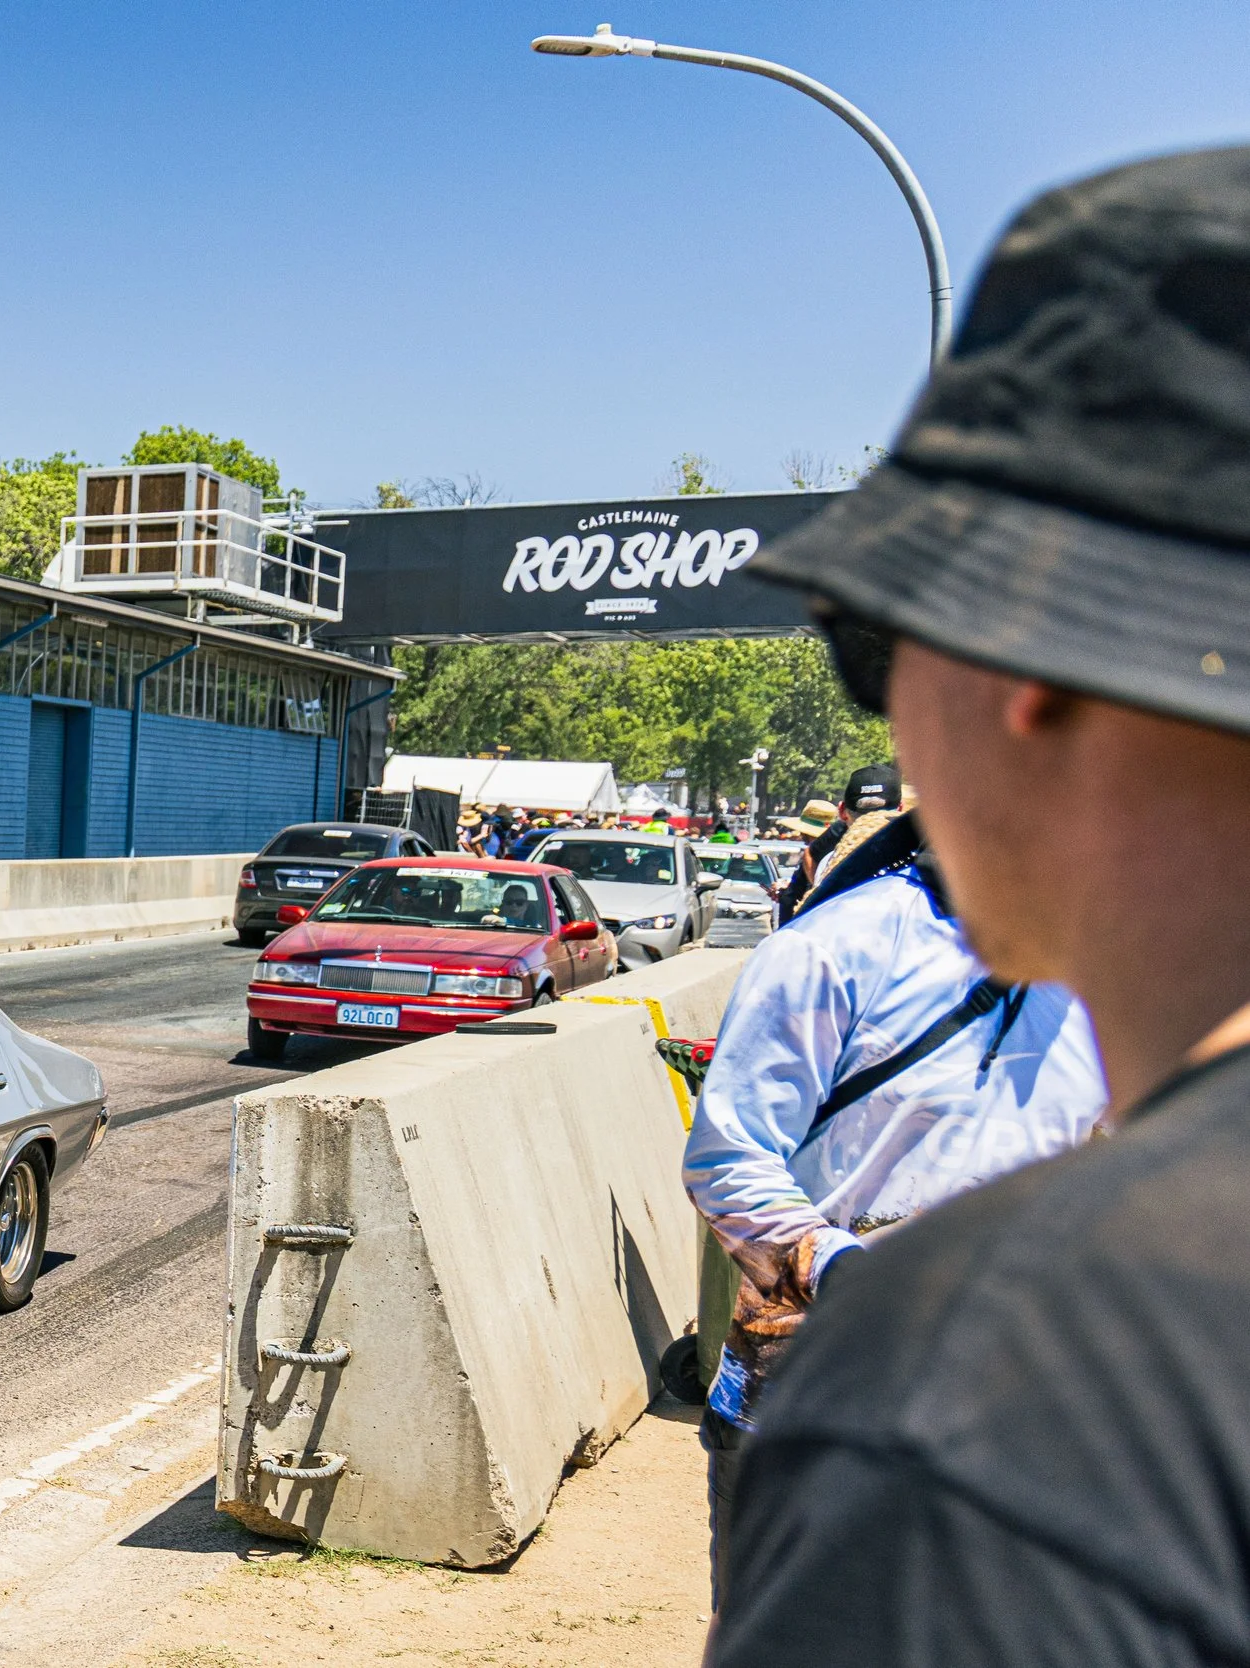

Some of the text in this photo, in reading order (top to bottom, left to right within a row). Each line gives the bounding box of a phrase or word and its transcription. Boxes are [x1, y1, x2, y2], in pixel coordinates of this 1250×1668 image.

[578, 510, 680, 531] CASTLEMAINE
[502, 527, 759, 593] ROD SHOP
